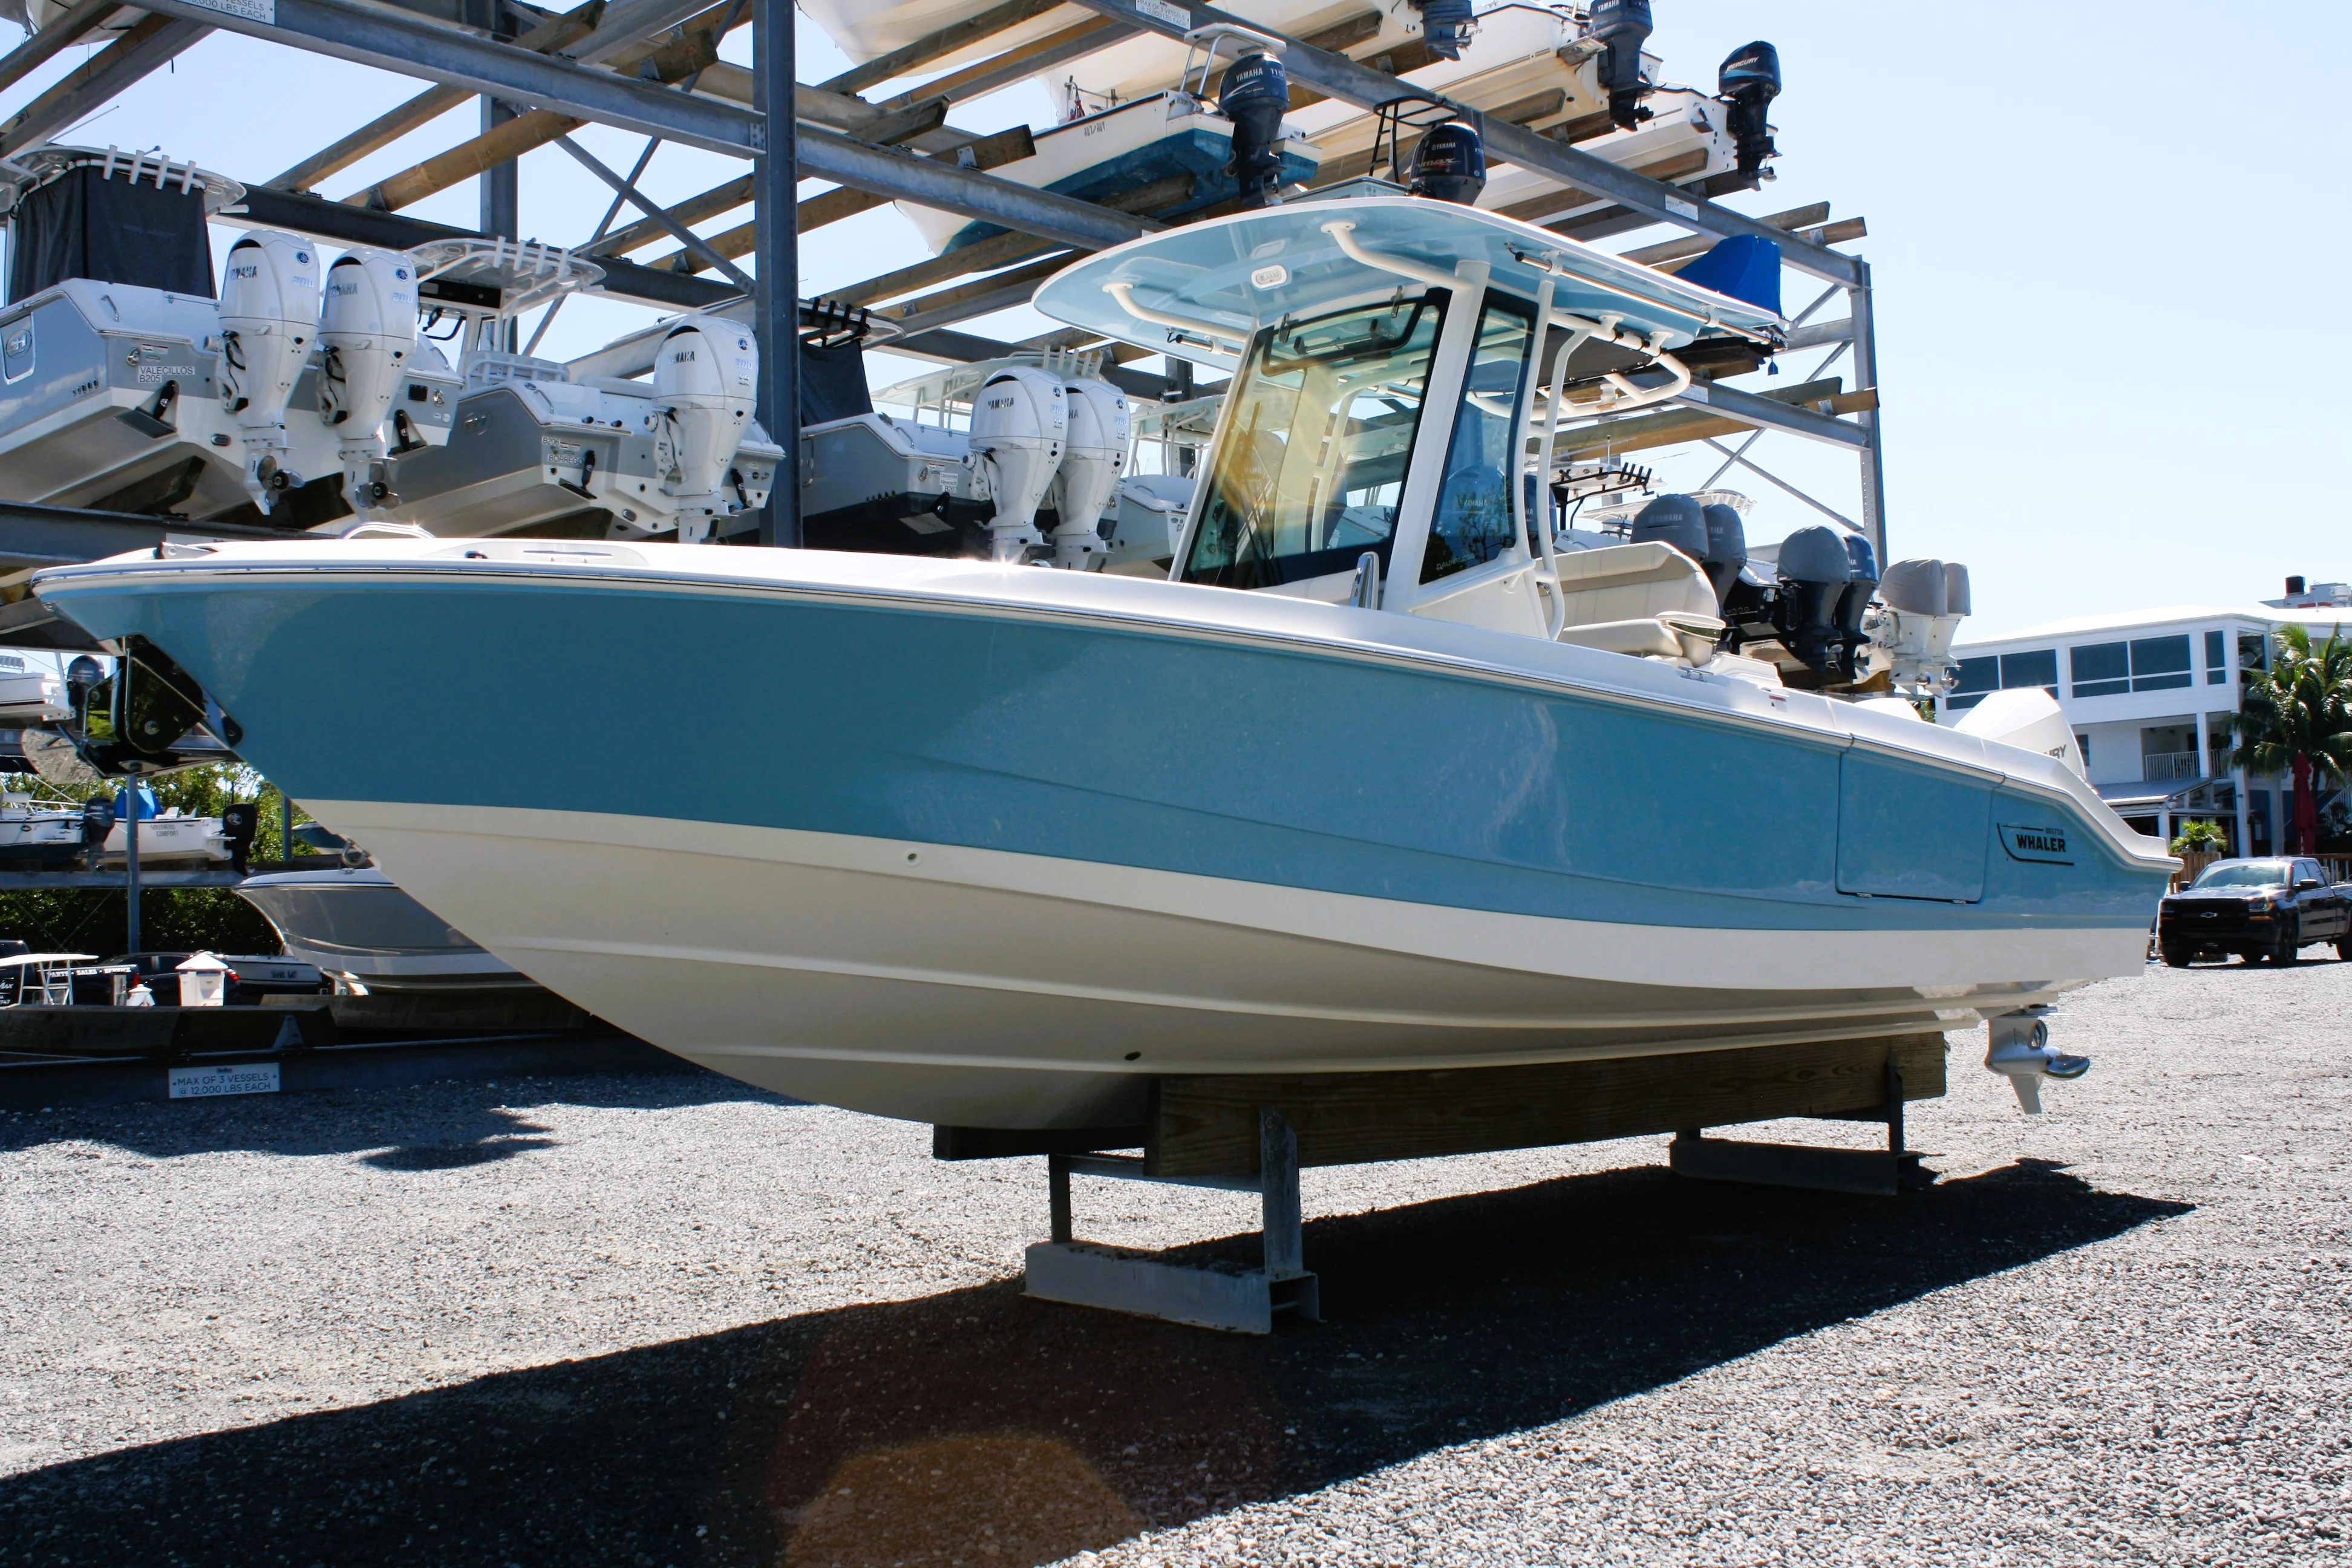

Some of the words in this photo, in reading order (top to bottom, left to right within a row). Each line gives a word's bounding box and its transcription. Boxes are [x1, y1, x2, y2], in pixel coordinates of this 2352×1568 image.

[221, 3, 238, 13] LBS
[241, 8, 266, 21] EACH
[226, 0, 265, 11] ESSELS
[1598, 0, 1620, 13] YAMAHA
[1725, 56, 1759, 74] MERCURY
[1236, 67, 1263, 82] YAMAHA
[140, 367, 193, 375] VALECILLOS
[988, 397, 1014, 410] YAMAHA
[542, 437, 560, 446] B206
[549, 454, 584, 465] BORREGO
[1656, 514, 1683, 522] YAMAHA
[2045, 827, 2063, 835] BOSTON
[2016, 834, 2066, 852] WHALER
[177, 1077, 199, 1086] MAX
[203, 1076, 216, 1085] OF
[227, 1073, 269, 1083] VESSELS
[191, 1086, 221, 1095] 12,000
[224, 1084, 242, 1093] LBS
[245, 1082, 271, 1091] EACH
